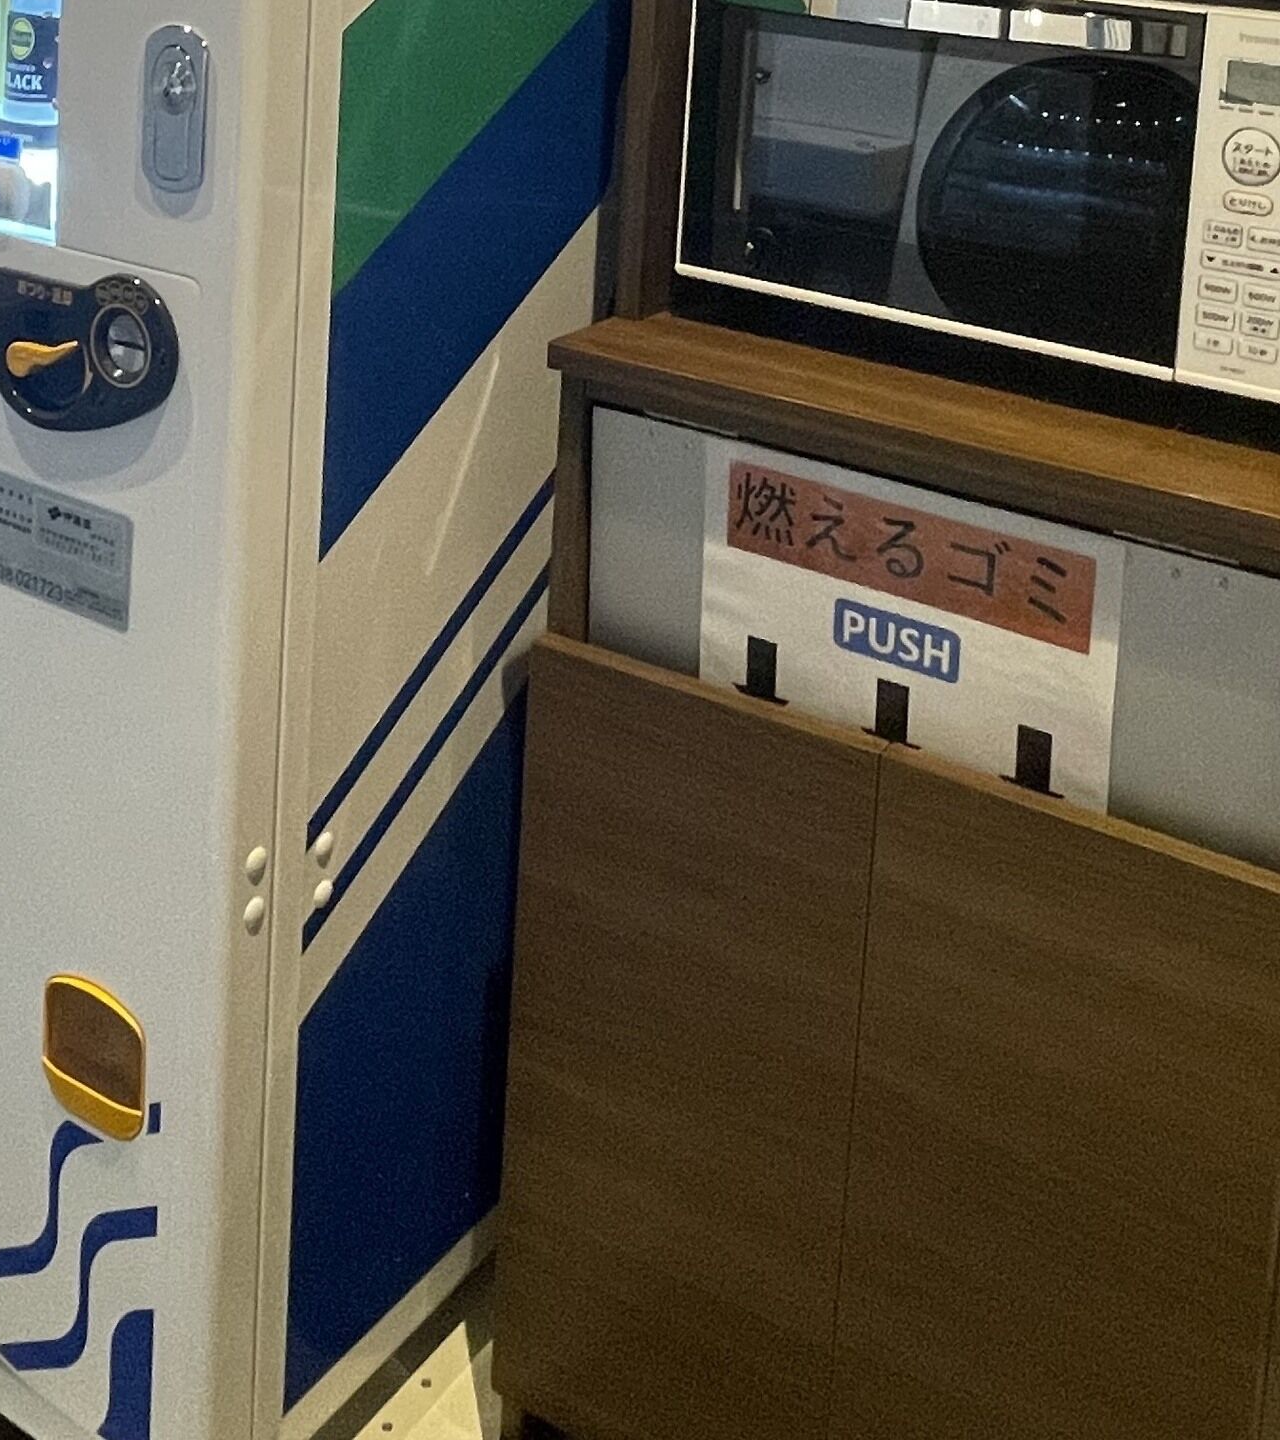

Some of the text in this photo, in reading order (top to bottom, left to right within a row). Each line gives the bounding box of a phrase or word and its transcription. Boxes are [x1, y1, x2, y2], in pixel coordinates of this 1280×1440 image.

[1232, 142, 1273, 157] スタート
[735, 470, 1068, 625] 燃えるゴミ
[841, 609, 952, 675] PUSH
